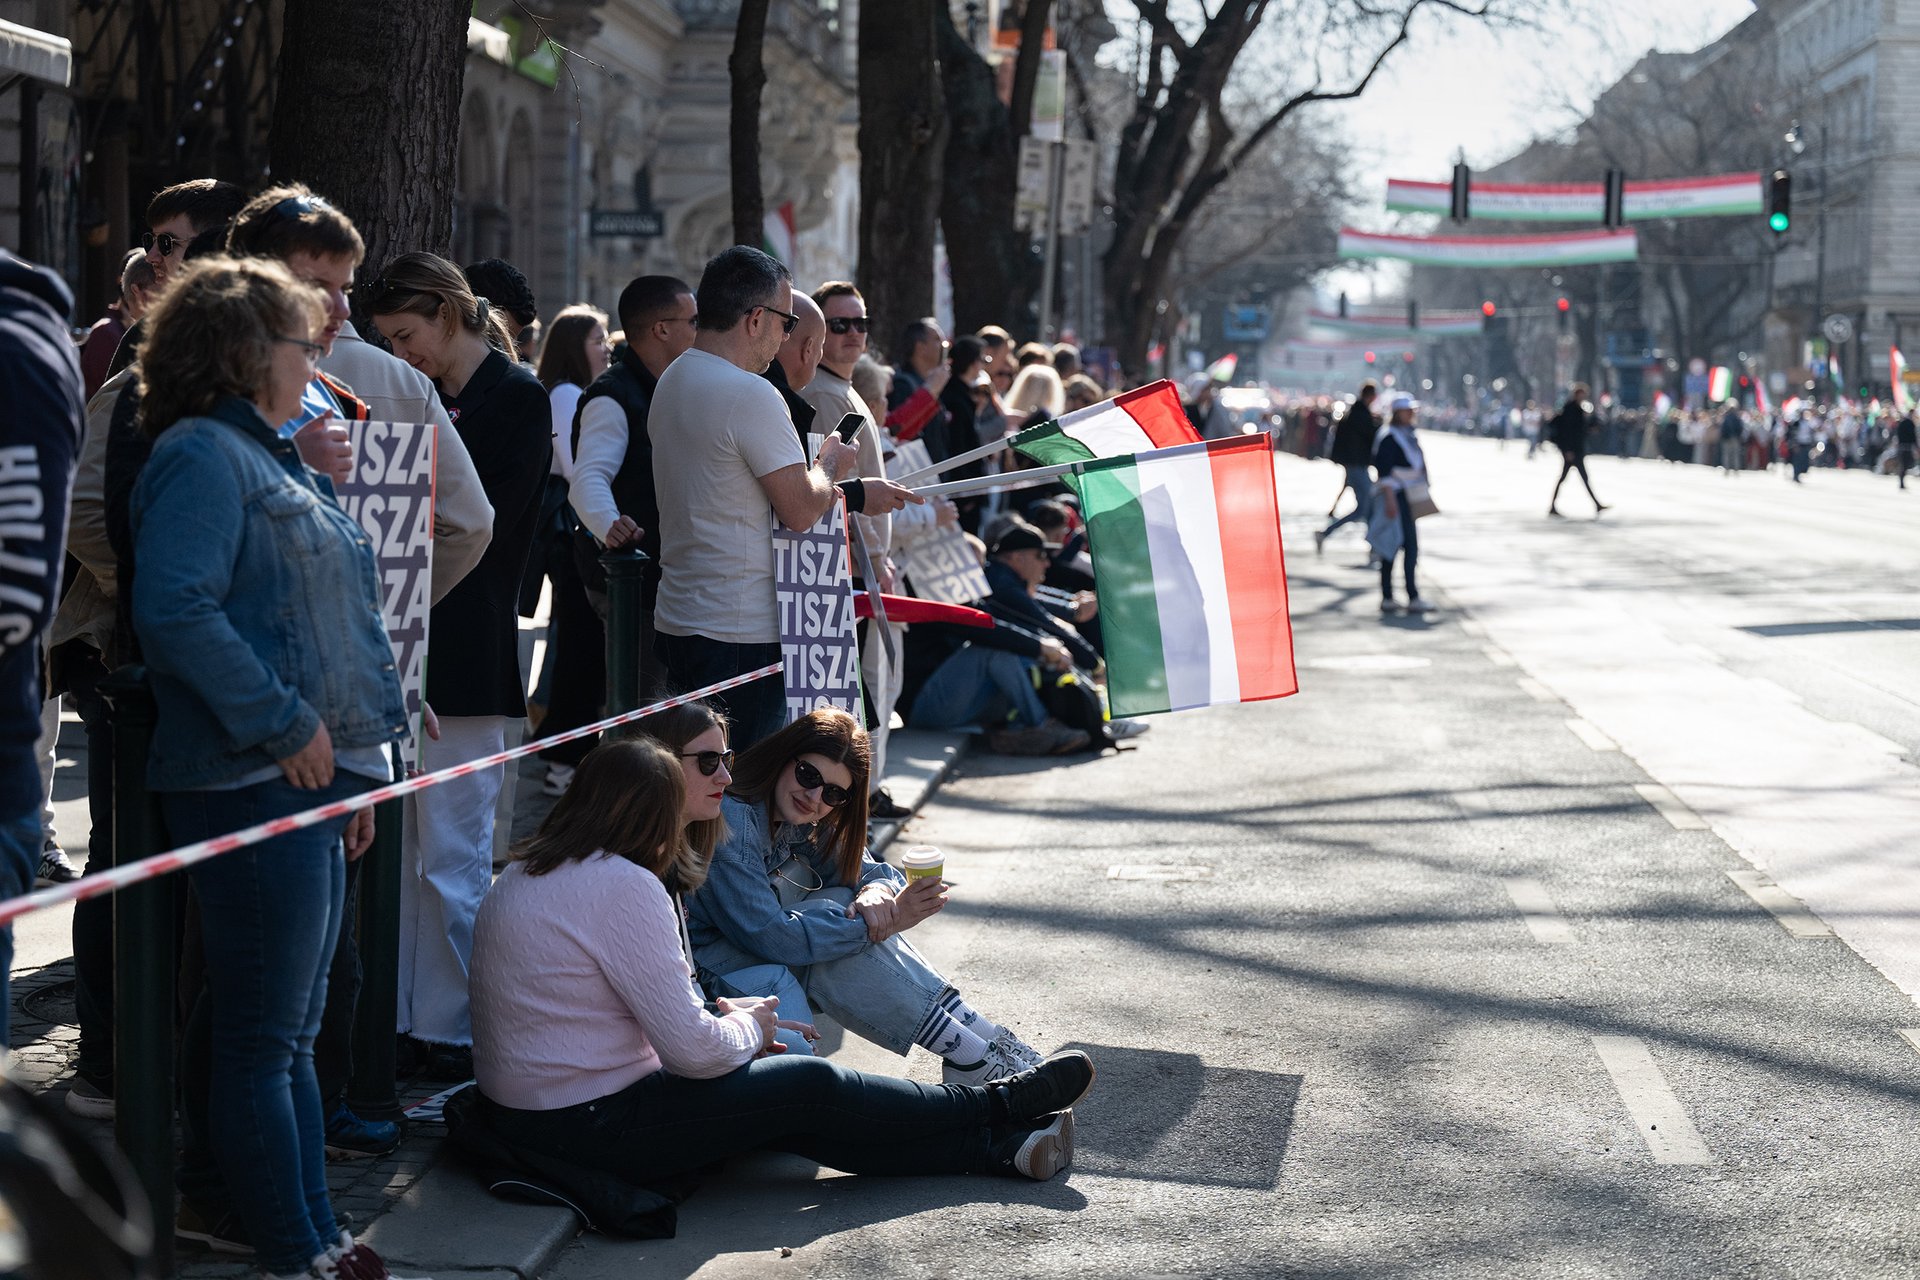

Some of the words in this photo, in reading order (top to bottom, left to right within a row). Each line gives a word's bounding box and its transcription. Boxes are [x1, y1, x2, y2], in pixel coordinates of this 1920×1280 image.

[326, 420, 434, 486] ISZA
[0, 445, 48, 655] HOLLIS
[337, 494, 432, 558] SZA
[772, 538, 851, 588] TISZA
[777, 591, 856, 638] TISZA
[782, 643, 860, 690] TISZA
